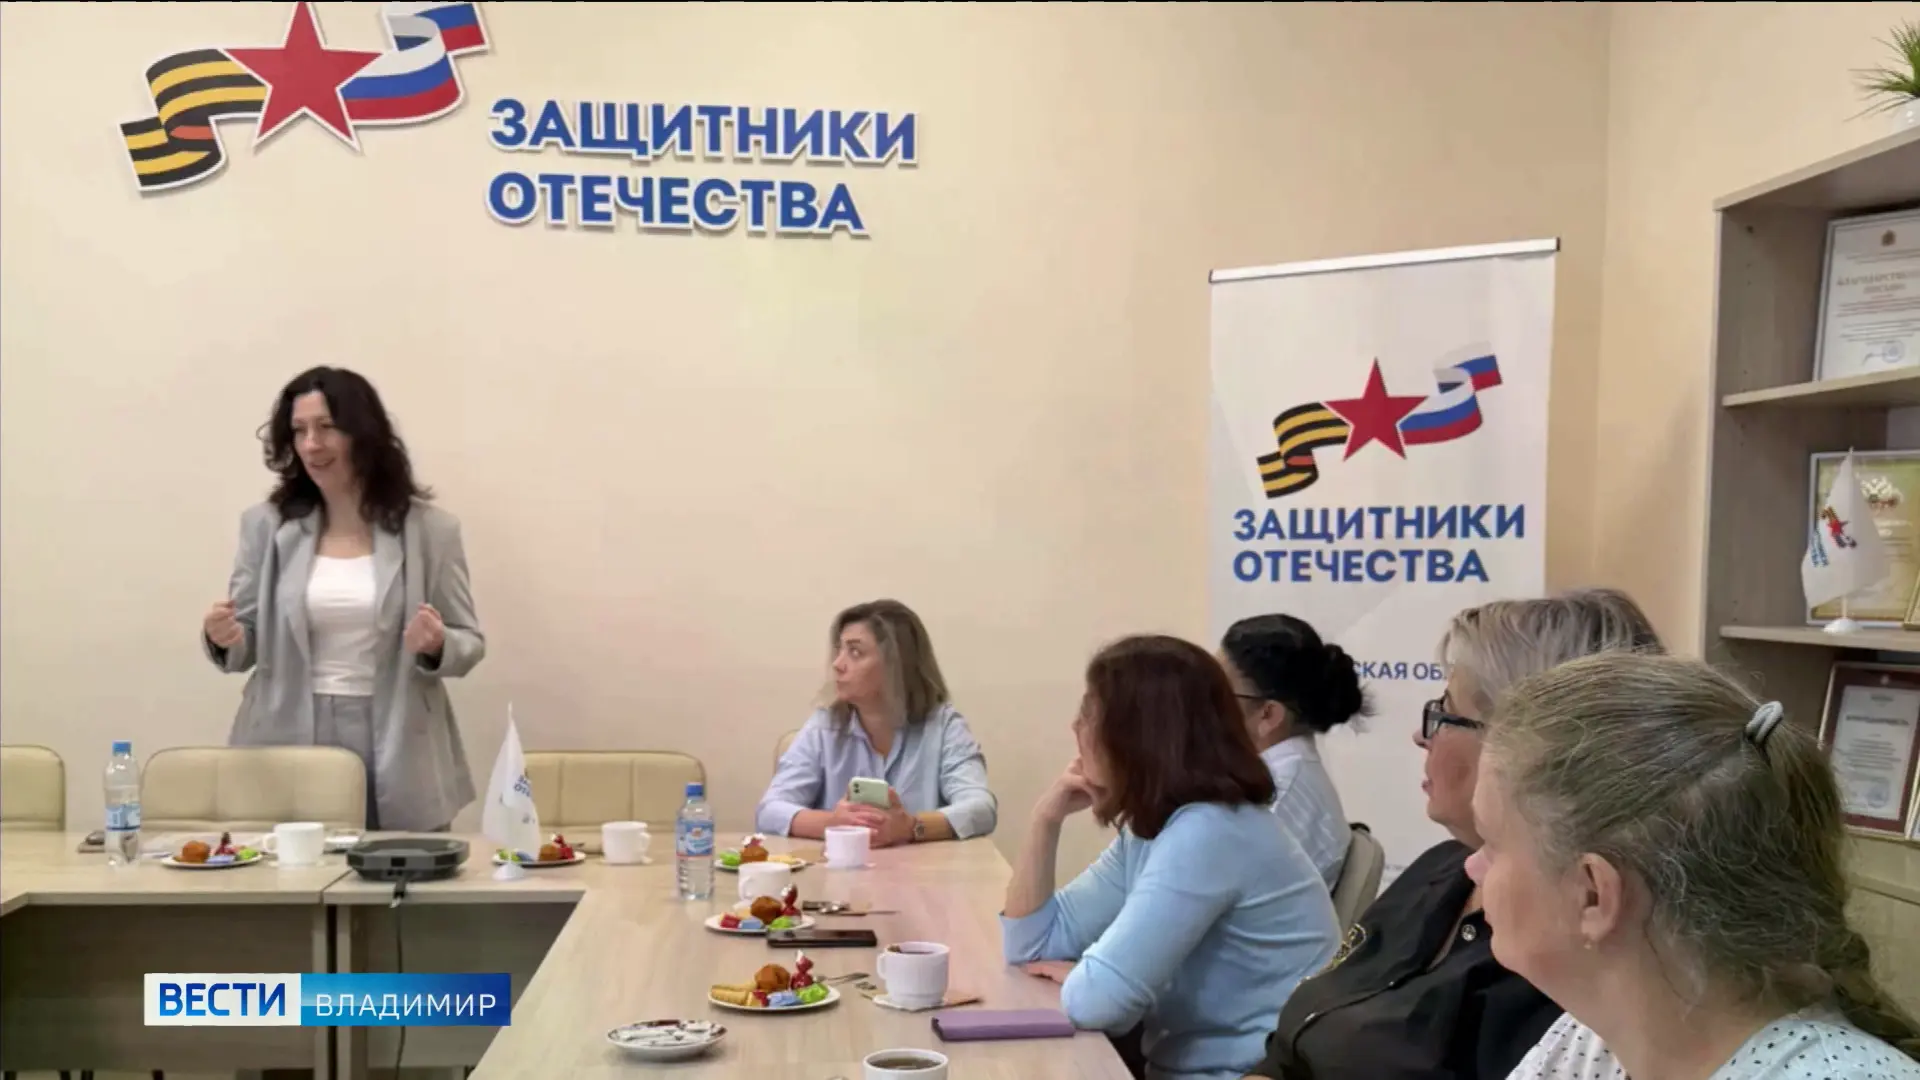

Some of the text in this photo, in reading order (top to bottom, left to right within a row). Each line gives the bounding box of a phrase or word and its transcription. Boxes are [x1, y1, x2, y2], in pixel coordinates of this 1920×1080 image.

[489, 97, 917, 162] ЗАЩИТНИКИ
[487, 170, 867, 232] ОТЕЧЕСТВА
[1233, 504, 1525, 544] ЗАЩИТНИКИ
[1232, 549, 1490, 582] ОТЕЧЕСТВА
[1412, 662, 1448, 681] ОБ
